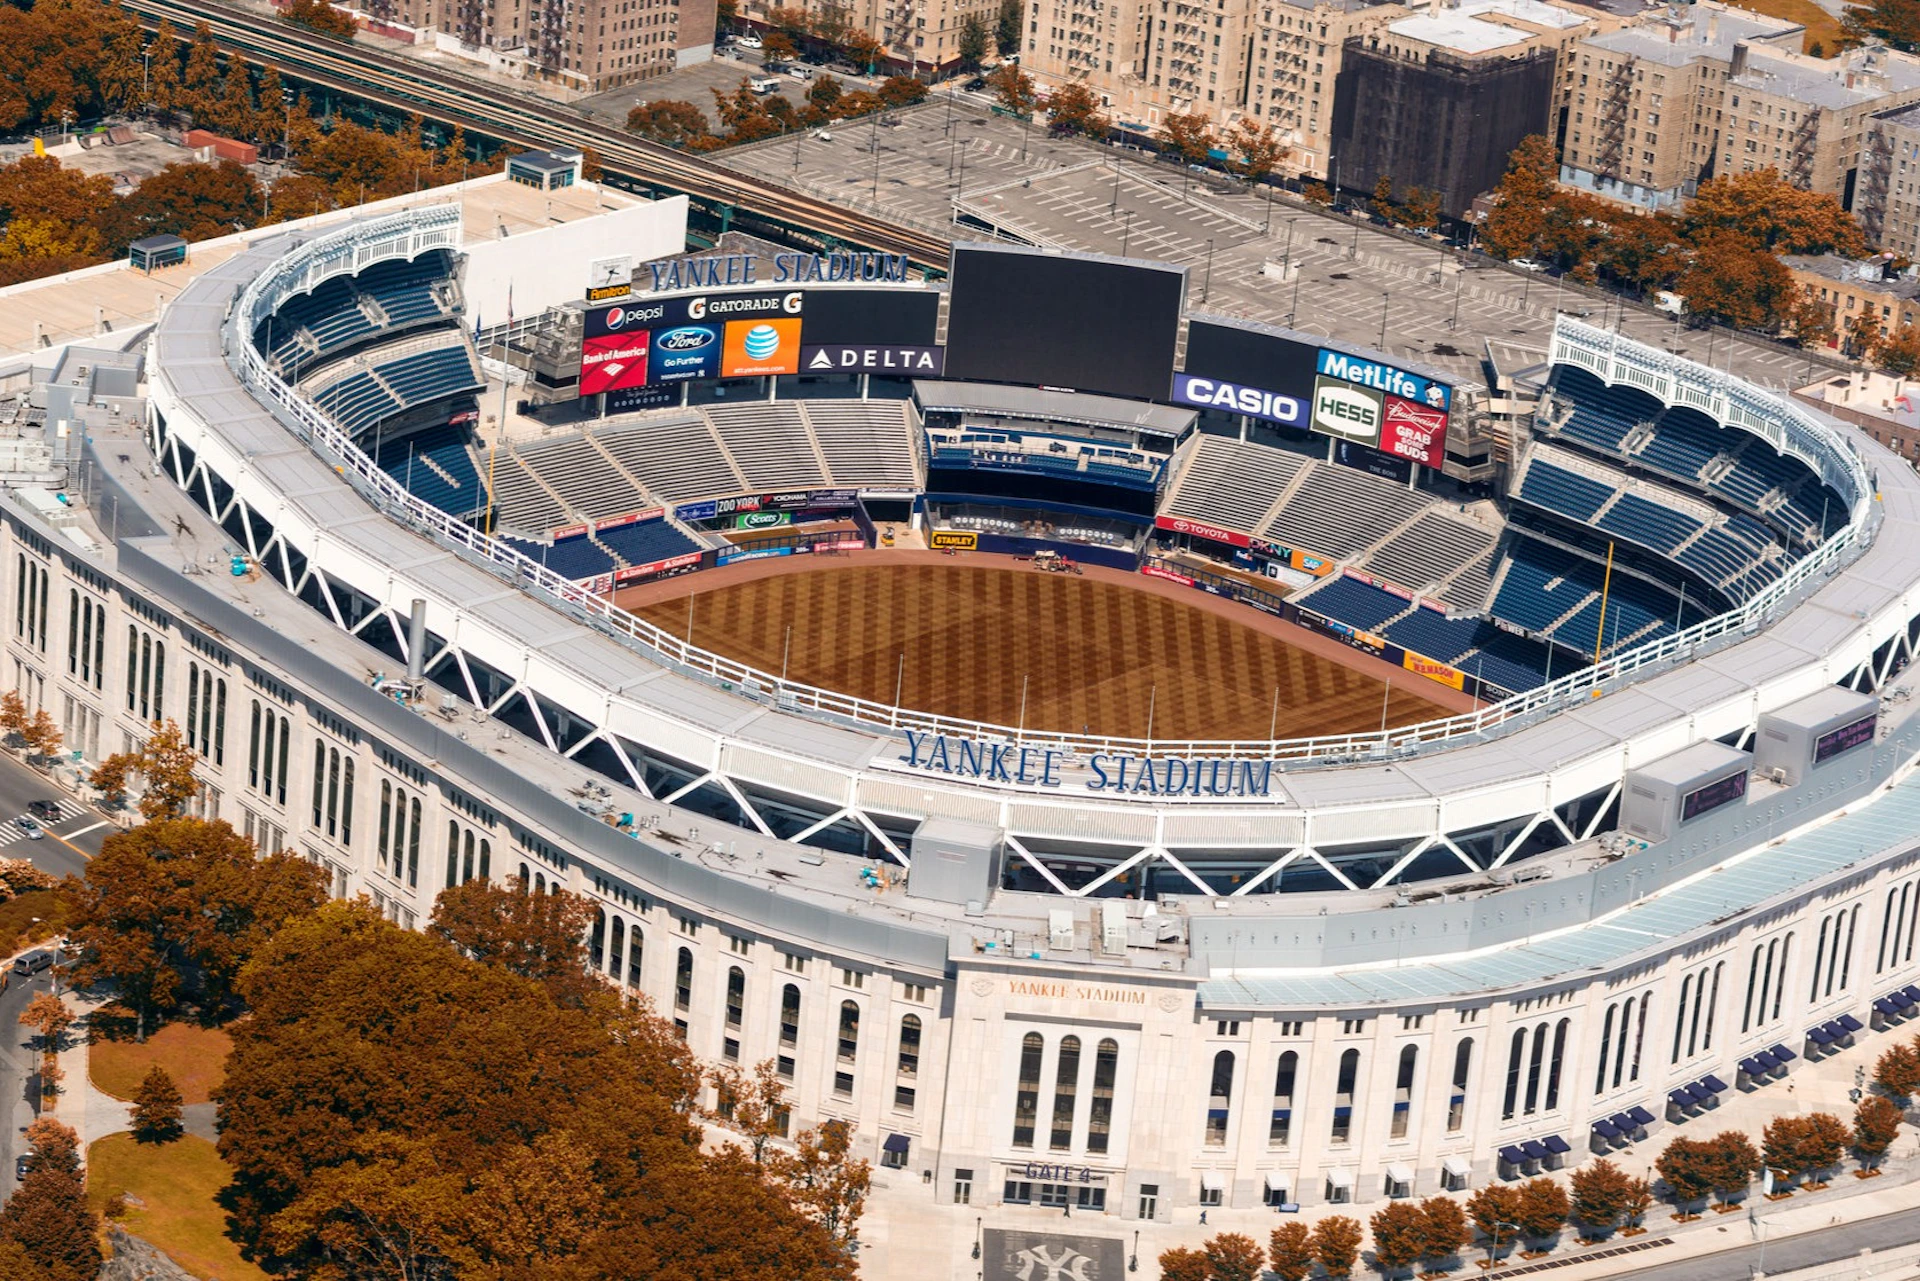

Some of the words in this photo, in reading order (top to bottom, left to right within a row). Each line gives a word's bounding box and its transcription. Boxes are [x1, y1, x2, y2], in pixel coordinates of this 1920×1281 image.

[650, 253, 758, 291] YANKEE
[772, 252, 909, 283] STADIUM
[590, 284, 631, 300] Armitron
[625, 305, 664, 324] pepsi
[688, 298, 706, 319] G
[709, 297, 780, 314] GATORADE
[783, 292, 803, 314] G
[668, 331, 703, 349] Ford
[583, 353, 603, 365] Bank
[604, 352, 613, 361] of
[613, 347, 646, 361] America
[664, 359, 675, 367] Go
[676, 356, 704, 366] Further
[841, 349, 935, 369] DELTA
[1323, 353, 1416, 399] MetLife
[1186, 378, 1299, 422] CASIO
[1320, 396, 1375, 426] HESS
[1387, 403, 1442, 430] Budweiser
[1396, 425, 1432, 445] GRAB
[1401, 437, 1425, 450] SOME
[1394, 441, 1429, 462] BUDS
[718, 500, 736, 512] ZOO
[736, 495, 760, 508] YORK
[773, 493, 808, 502] YOKOHAMA
[749, 513, 777, 524] Scotts
[936, 535, 973, 545] STANLEY
[1190, 524, 1230, 541] TOYOTA
[1250, 539, 1292, 558] DKNY
[1303, 557, 1320, 570] SAP
[1485, 684, 1511, 699] SONY
[903, 729, 1063, 788] YANKEE
[1087, 753, 1273, 796] STADIUM
[1009, 980, 1069, 999] YANKEE
[1076, 987, 1146, 1005] STADIUM
[1026, 1162, 1073, 1181] GATE
[1079, 1167, 1091, 1184] 4
